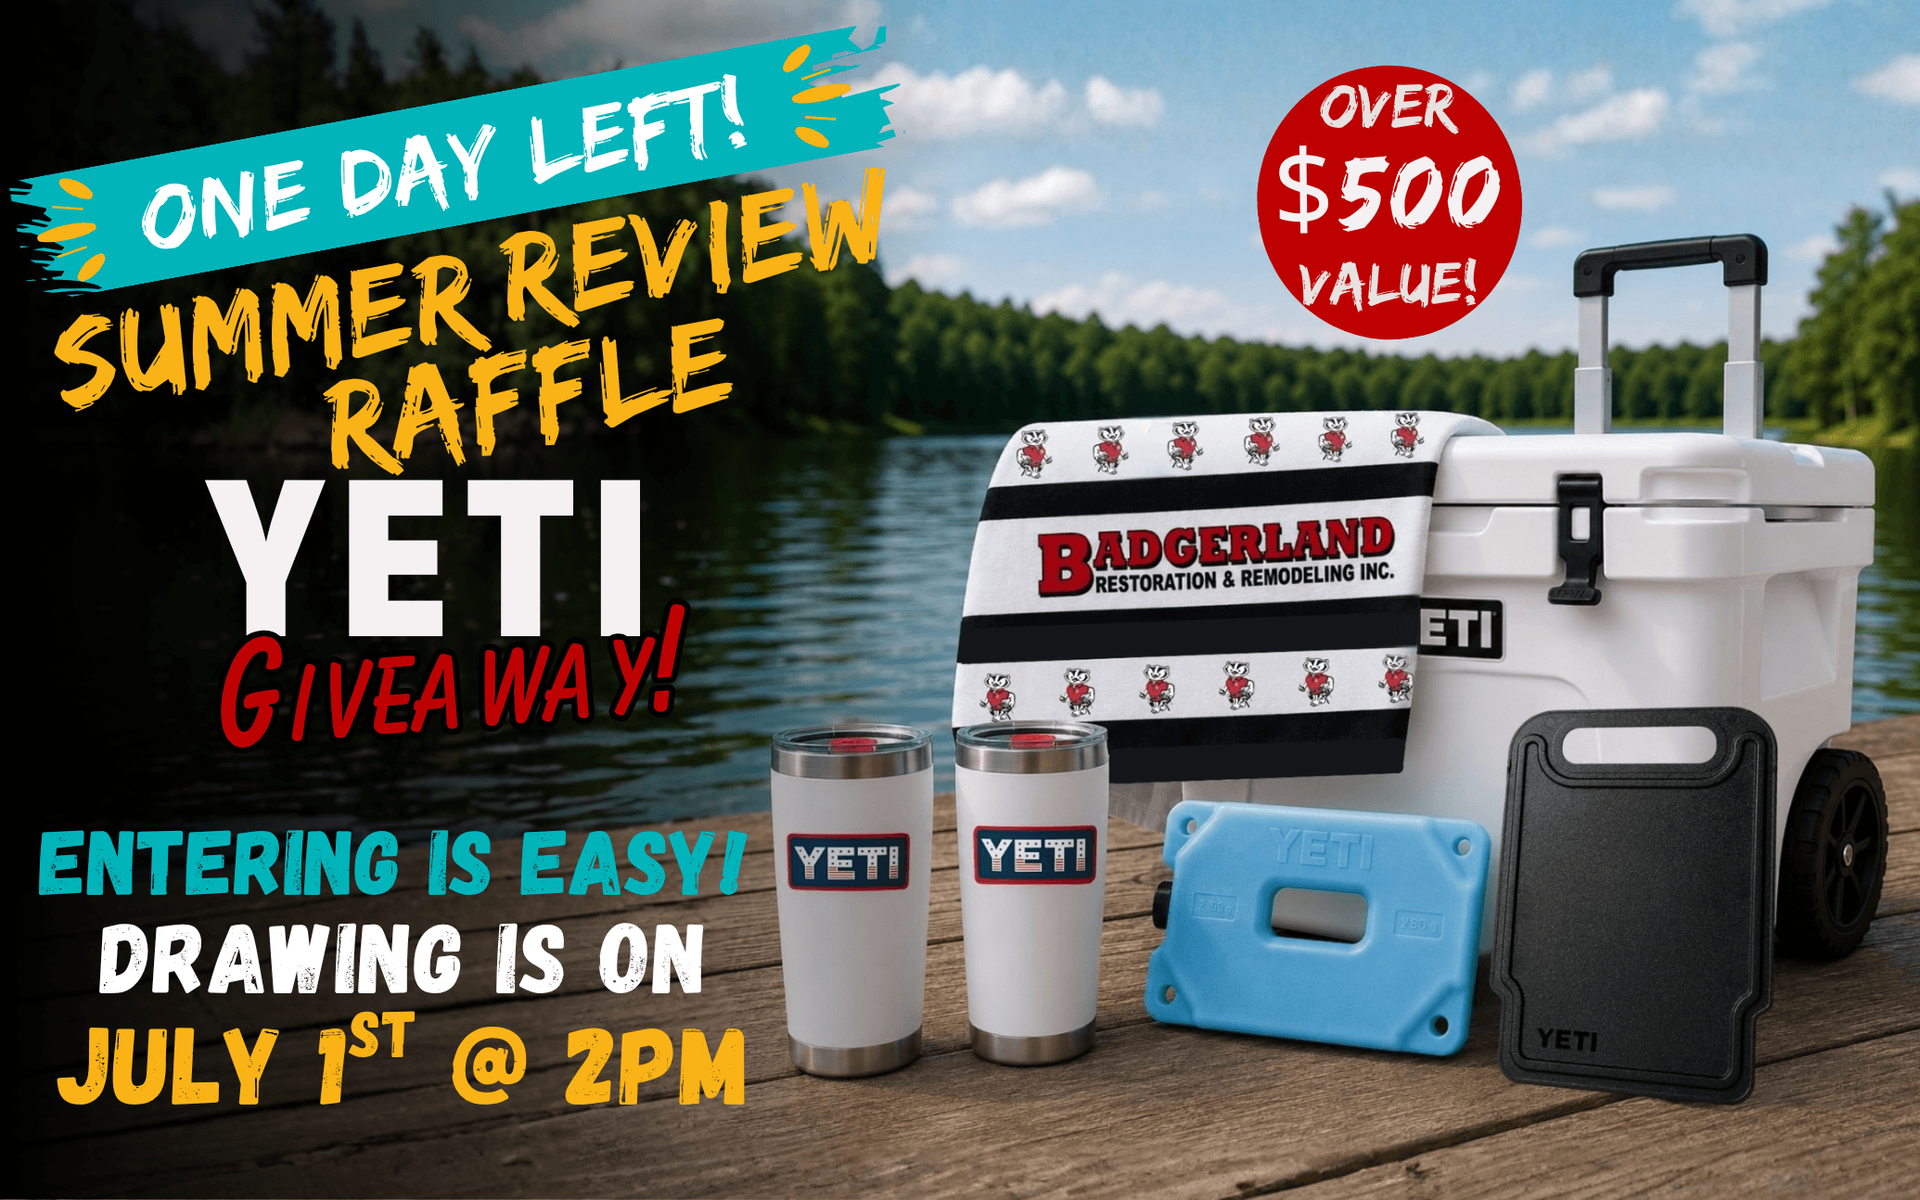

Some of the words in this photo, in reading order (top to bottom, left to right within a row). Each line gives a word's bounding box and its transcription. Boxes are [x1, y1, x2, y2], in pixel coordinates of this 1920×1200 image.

[1038, 516, 1396, 597] BADGERLAND
[1095, 571, 1217, 593] RESTORATION
[1223, 569, 1235, 587] &
[1241, 564, 1355, 586] REMODELING
[1360, 561, 1395, 580] INC.
[1420, 608, 1492, 648] ETI
[794, 846, 899, 880] YETI
[981, 837, 1086, 872] YETI
[1270, 827, 1374, 870] YETI
[1537, 1027, 1598, 1053] YETI
